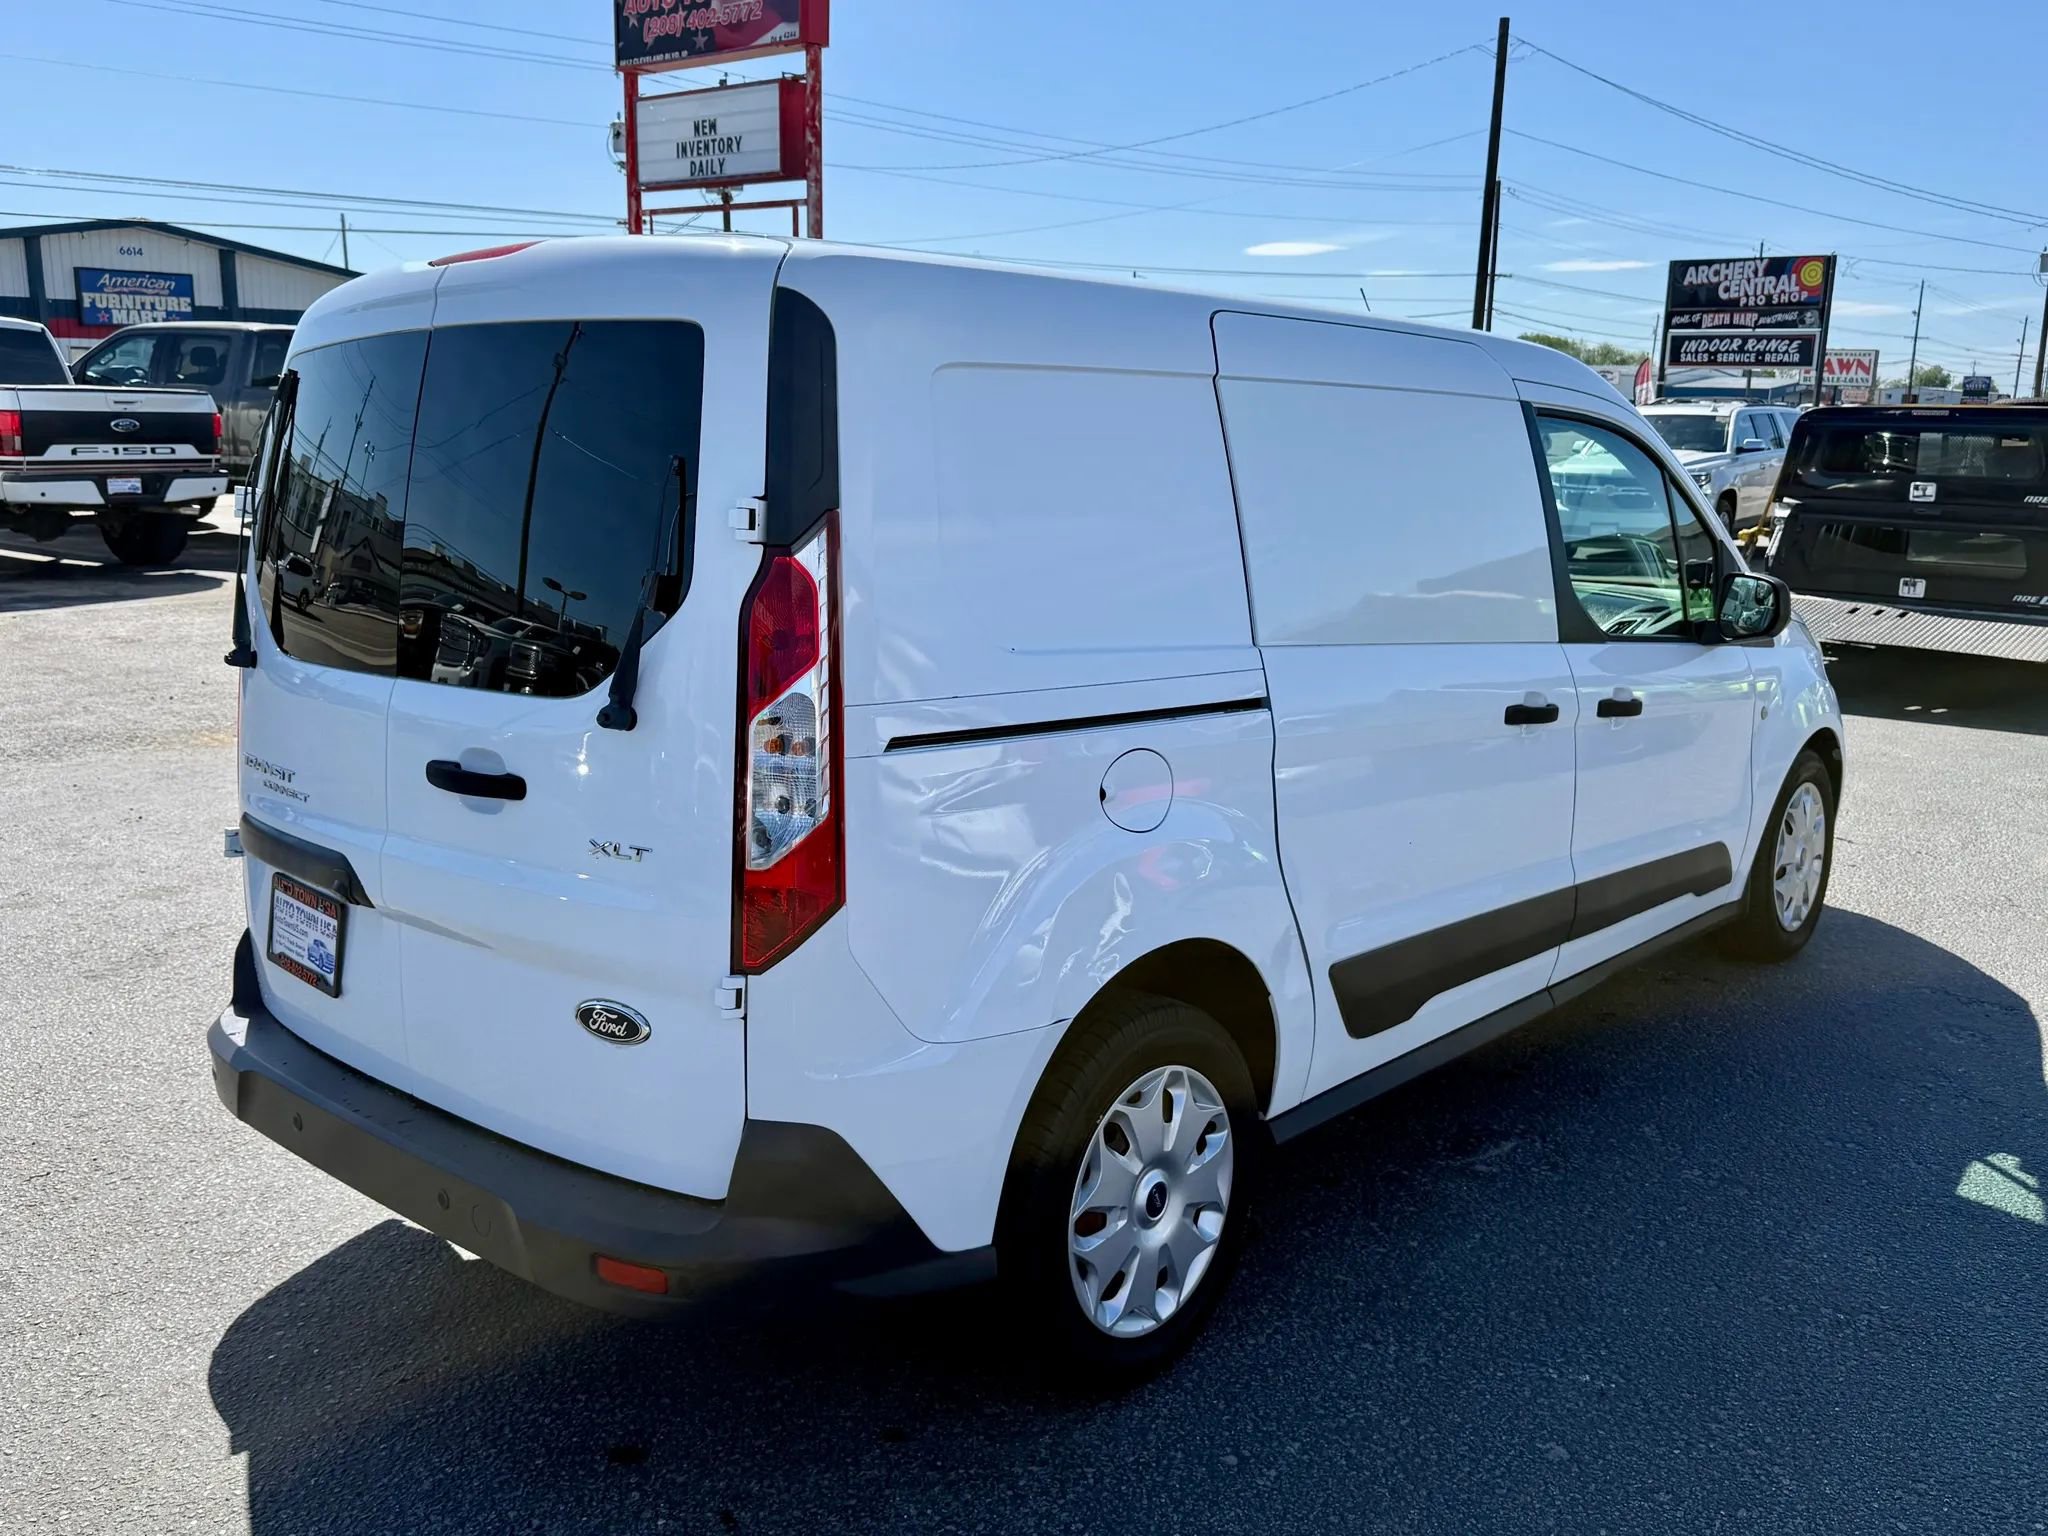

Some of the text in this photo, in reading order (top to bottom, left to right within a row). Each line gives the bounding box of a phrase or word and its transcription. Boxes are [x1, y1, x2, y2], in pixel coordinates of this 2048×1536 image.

[686, 1, 763, 30] 402-5772
[633, 53, 664, 64] CLEVELAND
[693, 118, 717, 137] NEW
[676, 136, 742, 159] INVENTORY
[689, 158, 726, 177] DAILY
[119, 247, 143, 256] 6614
[97, 273, 175, 290] American
[1683, 259, 1769, 286] ARCHERY
[1717, 274, 1800, 300] CENTRAL
[82, 292, 192, 312] FURNITURE
[1740, 291, 1809, 307] PRO SHOP
[111, 309, 167, 325] MART
[1691, 313, 1702, 322] OF
[1701, 313, 1730, 328] DEATH
[1732, 312, 1758, 328] HARP
[1680, 338, 1802, 354] INDOOR RANGE
[1680, 353, 1800, 362] SALES SERVICE REPAIR
[71, 446, 176, 456] F-150
[588, 838, 653, 862] XLT
[294, 885, 318, 908] TOWN
[589, 1009, 627, 1038] Ford
